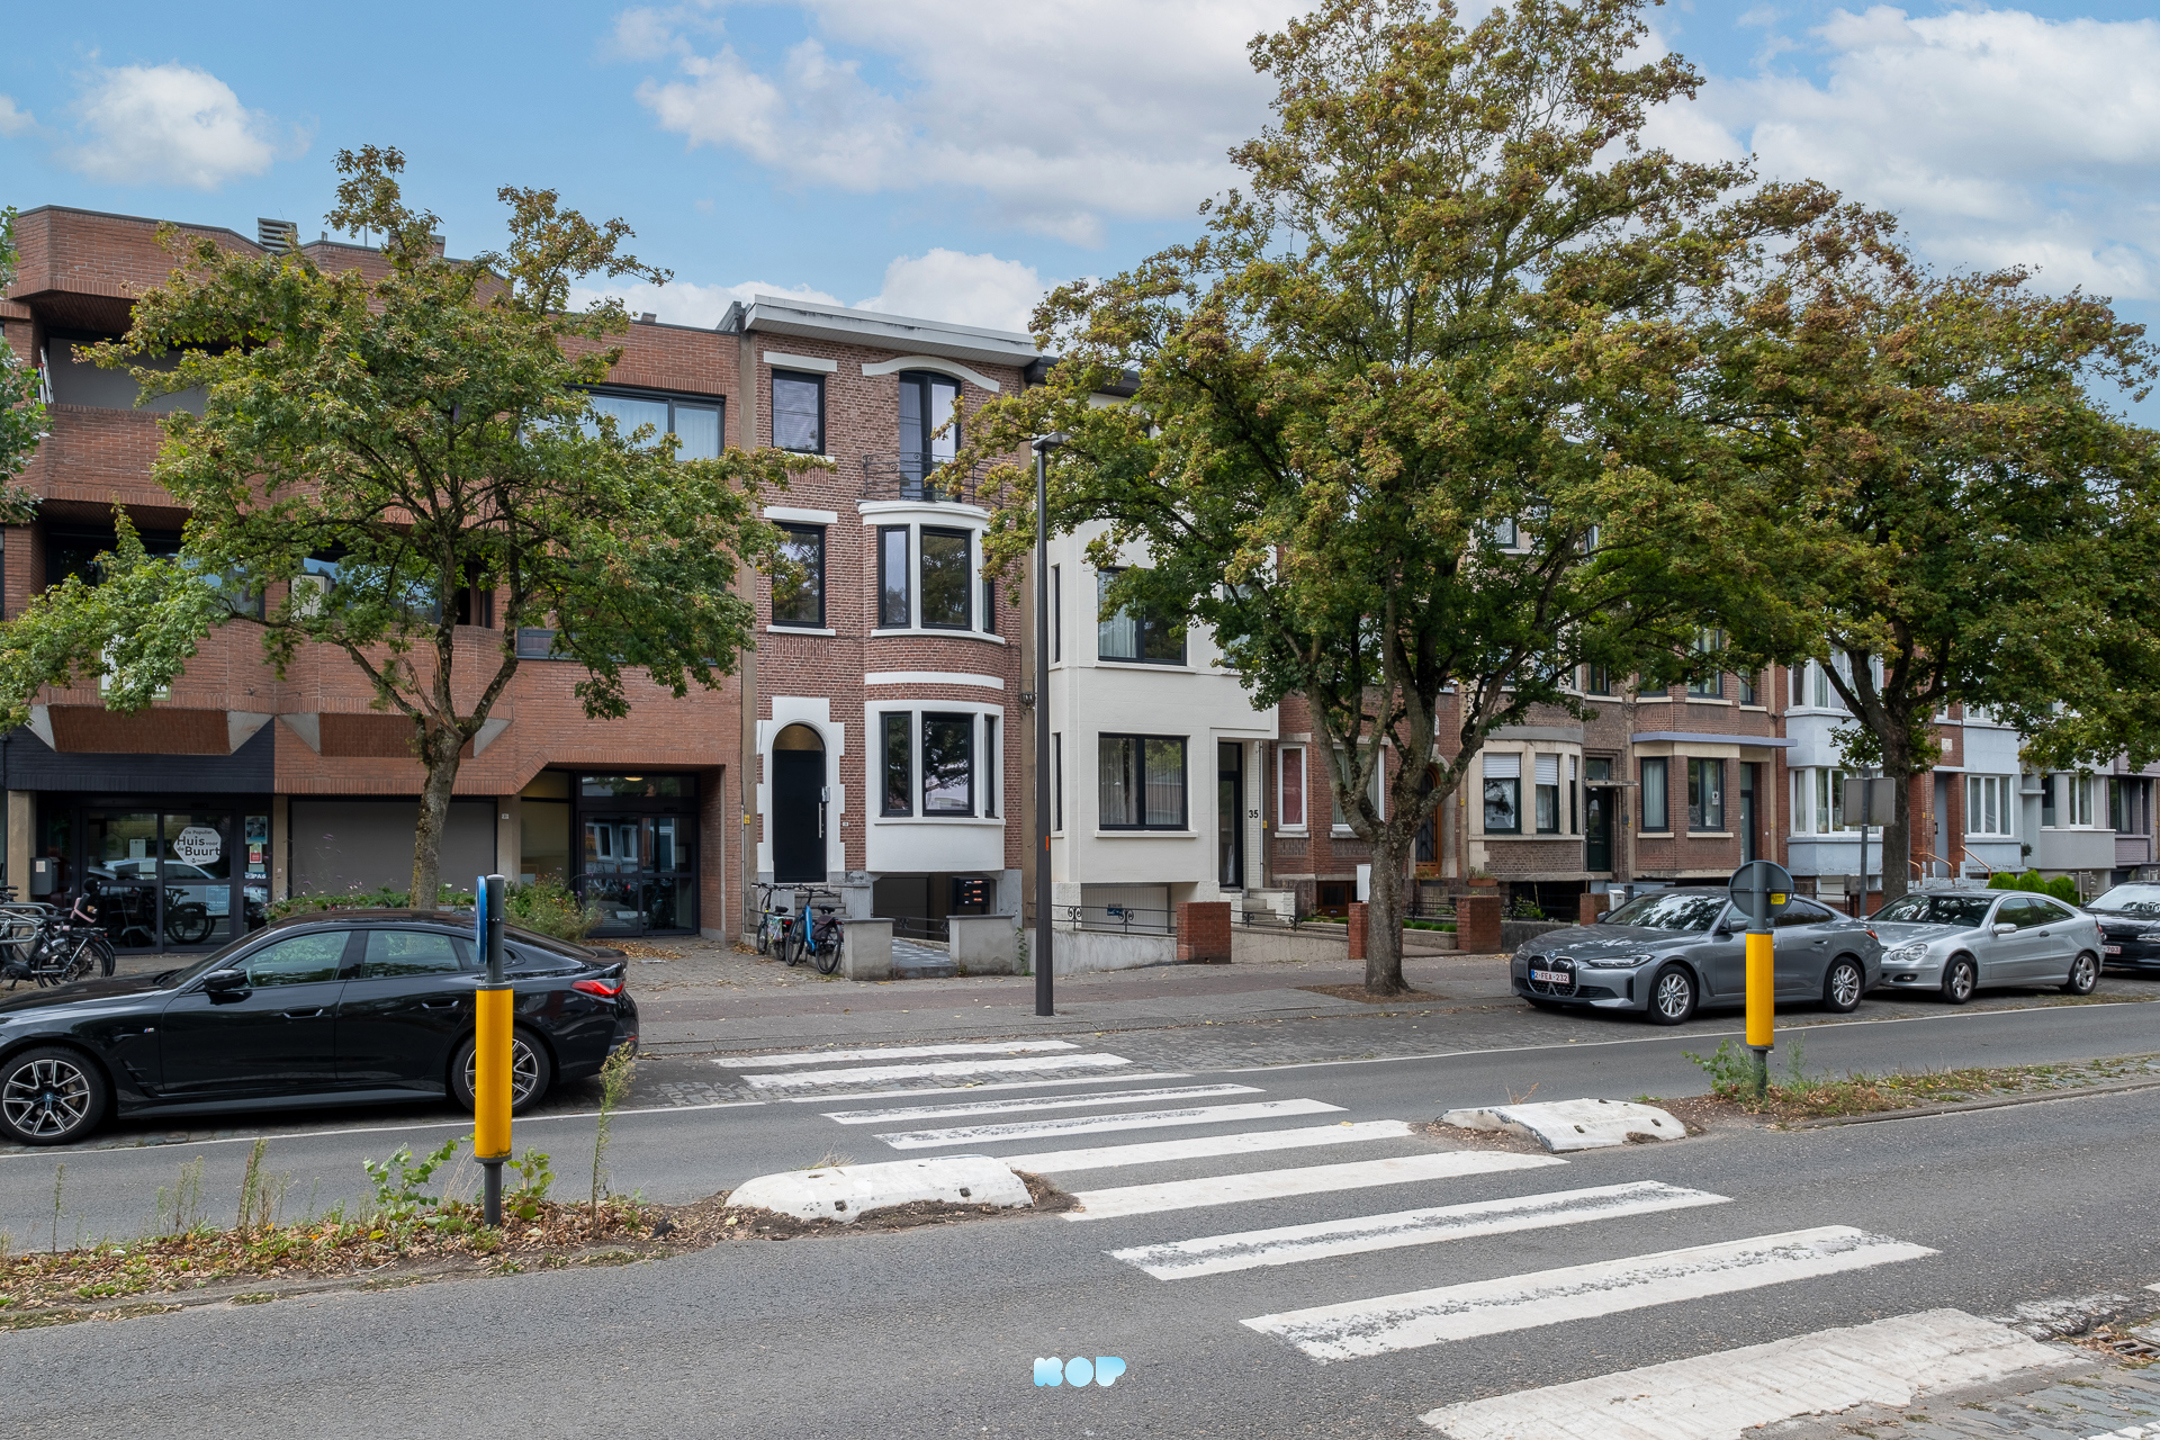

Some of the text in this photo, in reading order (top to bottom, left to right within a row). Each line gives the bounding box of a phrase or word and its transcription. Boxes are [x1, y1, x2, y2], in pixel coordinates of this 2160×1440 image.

[1248, 810, 1259, 818] 35
[177, 836, 205, 846] Huis
[185, 846, 221, 856] Buurt
